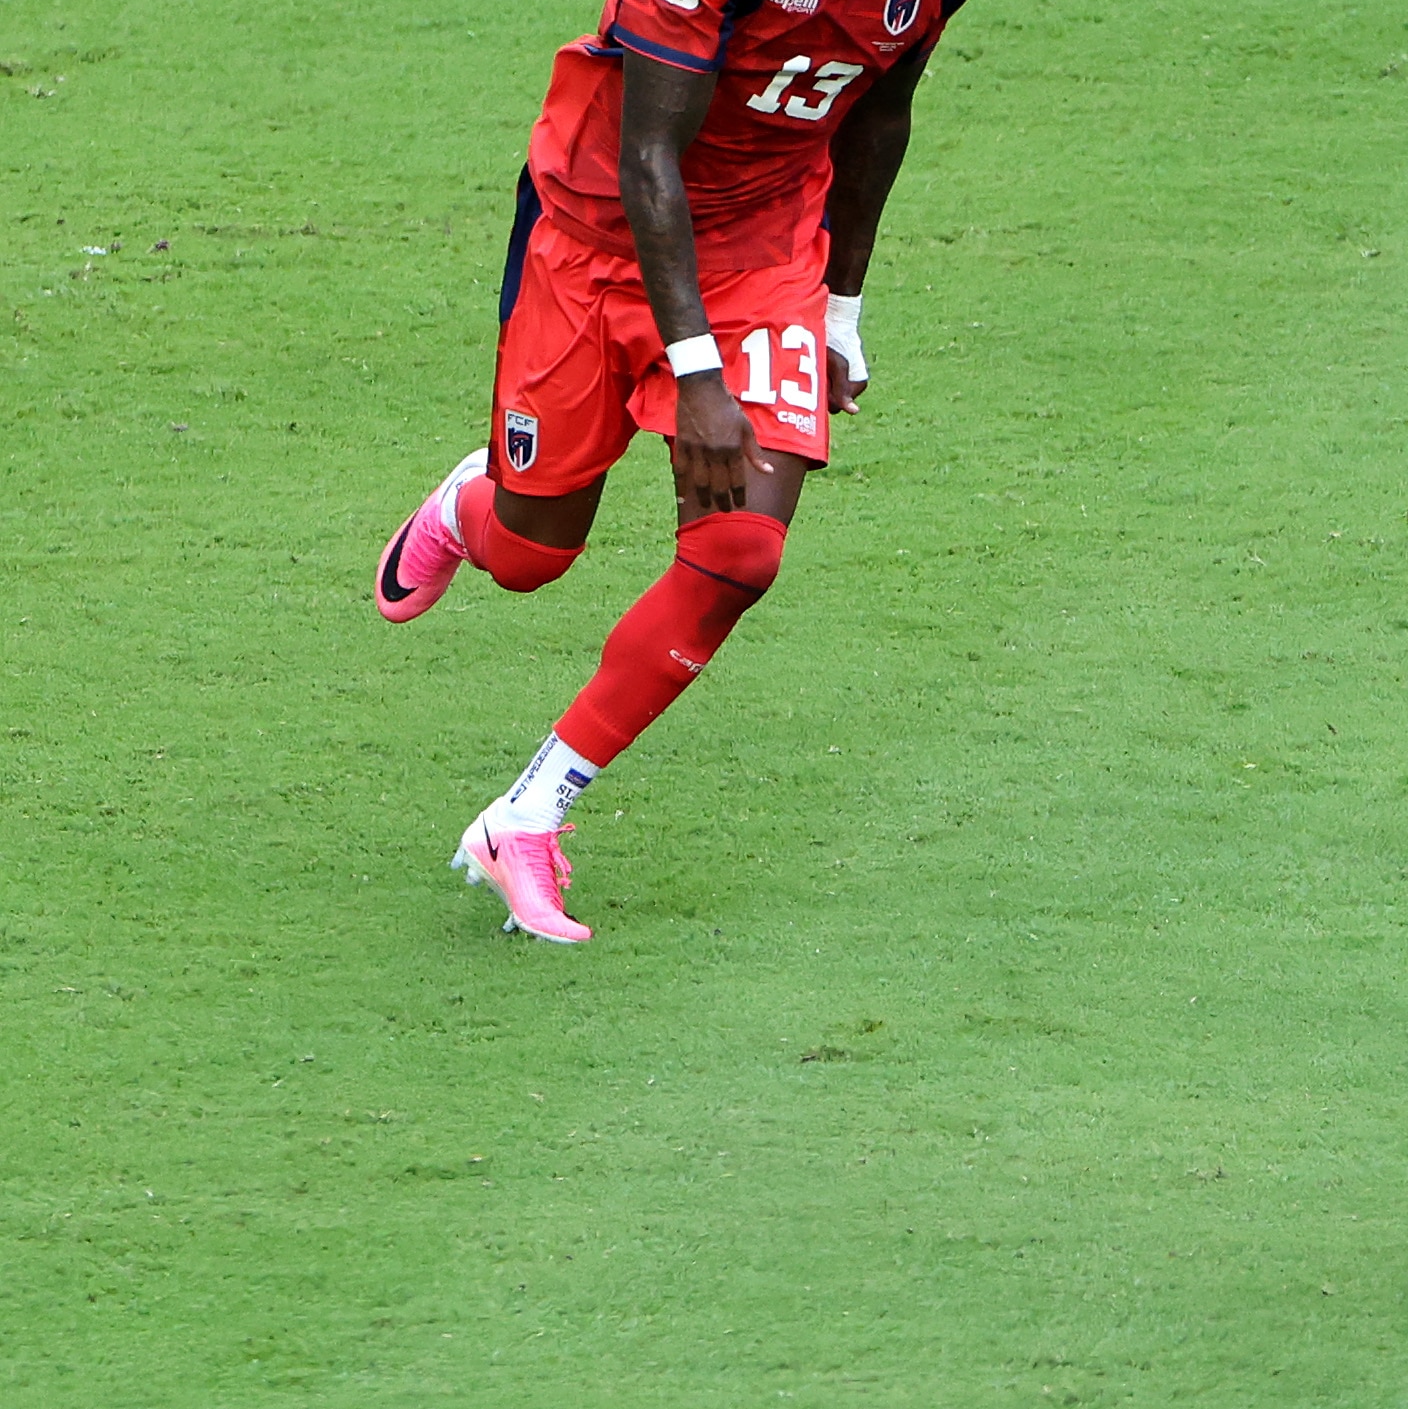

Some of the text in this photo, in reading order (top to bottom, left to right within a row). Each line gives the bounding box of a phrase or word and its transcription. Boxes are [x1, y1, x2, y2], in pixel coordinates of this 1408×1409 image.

[745, 55, 865, 121] 13
[740, 324, 819, 412] 13
[507, 412, 535, 427] FCF
